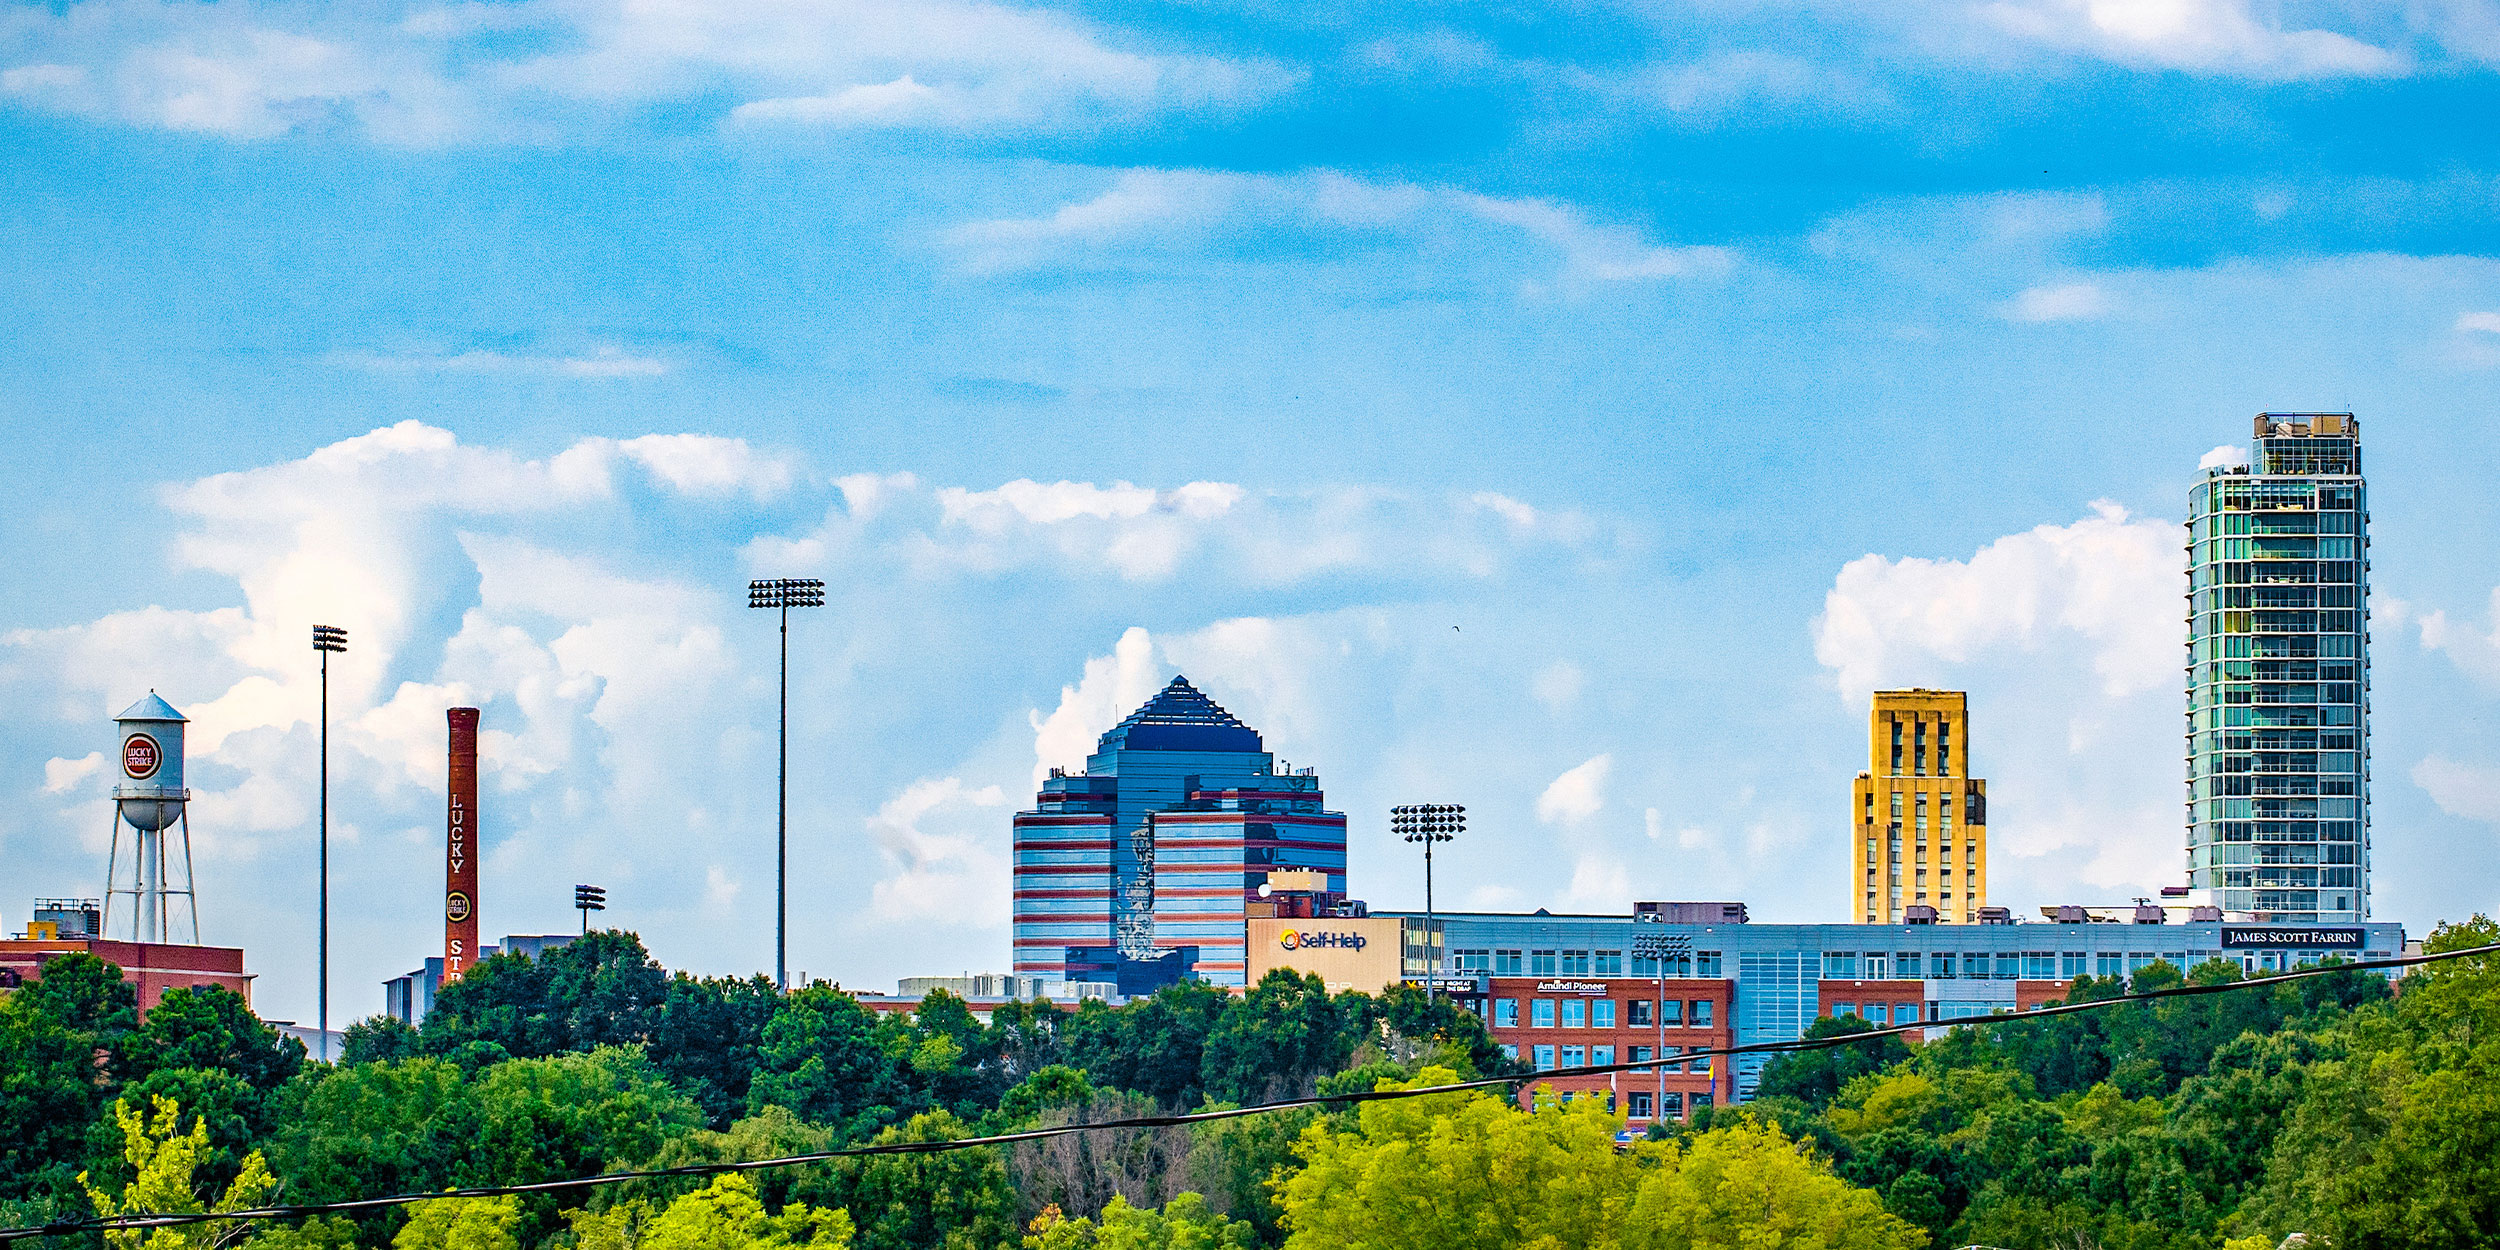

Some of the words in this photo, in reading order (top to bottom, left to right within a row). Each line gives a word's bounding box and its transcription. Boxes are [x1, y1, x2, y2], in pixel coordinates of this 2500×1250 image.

[127, 747, 151, 757] LUCKY
[127, 757, 152, 767] STRIKE
[451, 794, 464, 873] LUCKY
[1300, 931, 1366, 952] Self-Help
[2229, 931, 2267, 944] JAMES
[2268, 931, 2309, 943] SCOTT
[2311, 931, 2357, 943] FARRIN
[1537, 981, 1572, 990] Amundi
[1573, 982, 1606, 990] Pioneer
